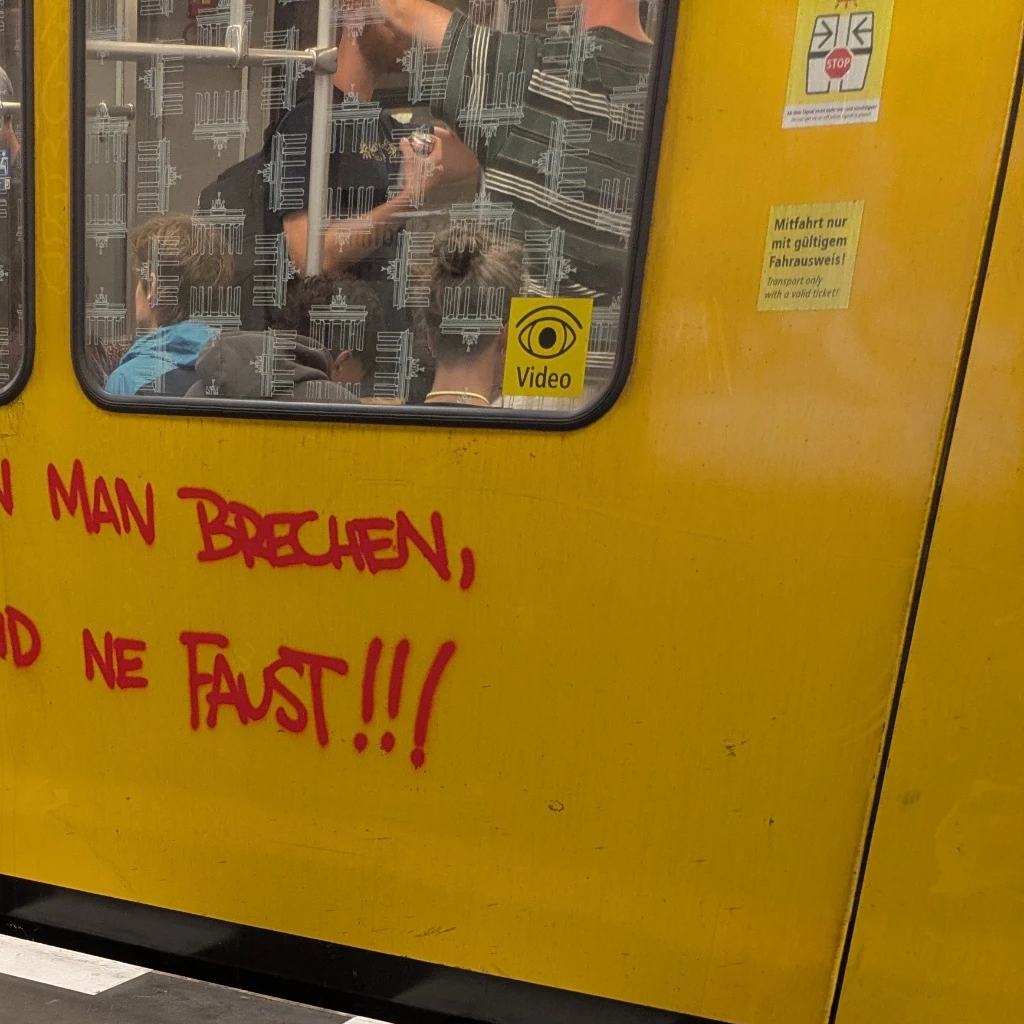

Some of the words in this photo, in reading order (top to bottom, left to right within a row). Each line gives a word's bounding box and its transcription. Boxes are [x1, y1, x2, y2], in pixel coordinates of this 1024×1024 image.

[826, 57, 851, 70] STOP
[774, 216, 824, 231] Mitfahrt
[826, 217, 848, 229] nur
[771, 236, 791, 250] mit
[794, 234, 847, 252] gültigem
[769, 253, 846, 268] Fahrausweis!
[767, 276, 804, 287] Transport
[805, 275, 823, 287] only
[764, 290, 782, 299] with
[783, 291, 790, 299] a
[791, 289, 812, 298] valid
[812, 288, 840, 298] ticket!
[516, 365, 572, 389] Video
[46, 458, 156, 547] MAN
[176, 486, 477, 592] BRECHEN,
[81, 627, 149, 691] NE
